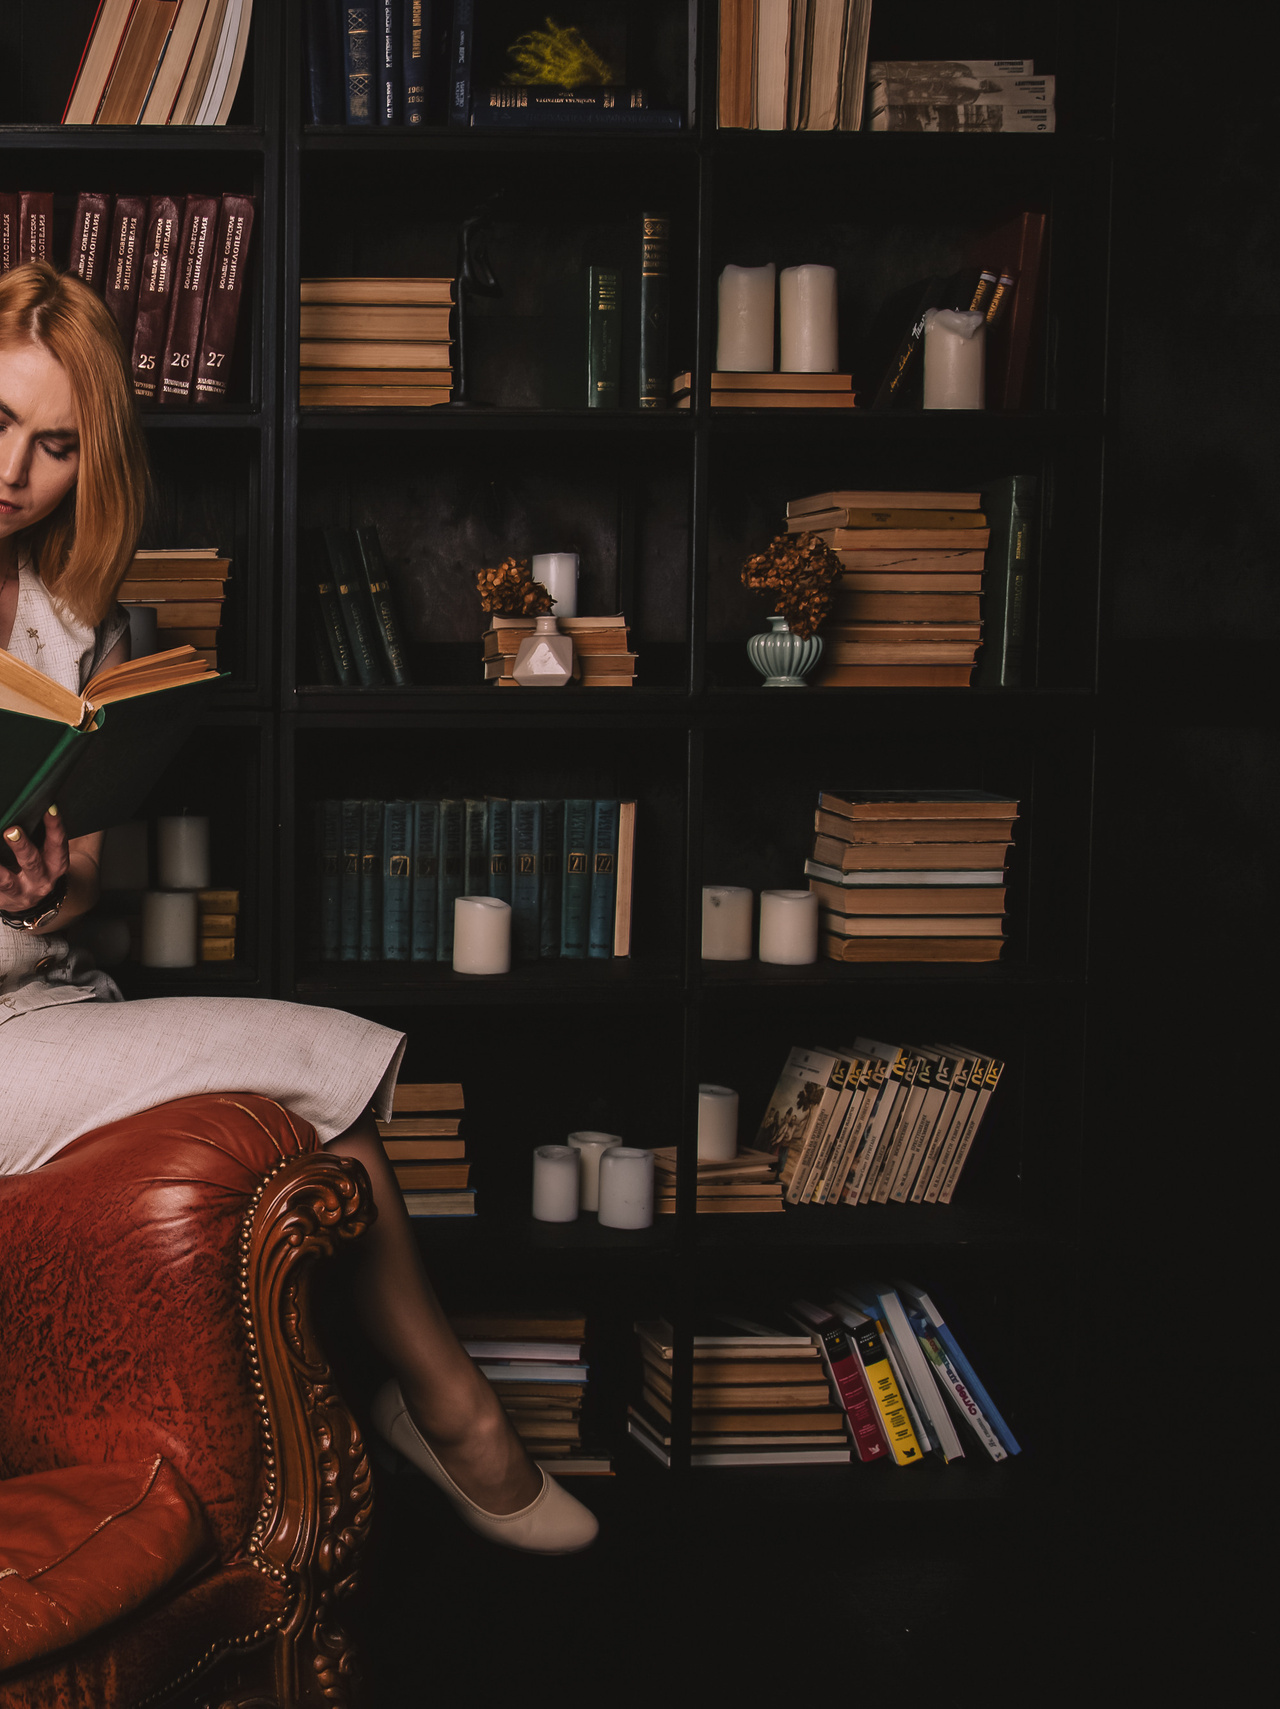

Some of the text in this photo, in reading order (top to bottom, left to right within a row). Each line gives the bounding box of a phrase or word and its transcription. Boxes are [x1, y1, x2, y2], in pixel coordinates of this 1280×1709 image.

[81, 212, 92, 252] СОВЕТСКАЯ
[85, 213, 100, 284] НЦИКЛОПЕДИЯ
[115, 217, 129, 290] БОЛЬШАЯ СОВЕТСКАЯ
[122, 218, 137, 290] ЭНЦИКЛОПЕДИЯ
[149, 218, 164, 292] БОЛЬШАЯ СОВЕТСКАЯ
[158, 219, 172, 293] ЭНЦИКЛОПЕДИЯ
[183, 216, 200, 289] БОЛЬШАЯ СОВЕТСКАЯ
[192, 217, 209, 291] ЭНЦИКЛОПЕДИЯ
[219, 215, 235, 289] БОЛЬШАЯ СОВЕТСКАЯ
[227, 217, 244, 290] ЭНЦИКЛОПЕДИЯ
[138, 354, 156, 370] 25
[171, 352, 190, 368] 26
[206, 352, 225, 367] 27
[396, 859, 404, 875] 7
[520, 856, 532, 873] 12
[572, 856, 583, 872] 21
[598, 856, 612, 872] 22
[953, 1382, 979, 1417] супер
